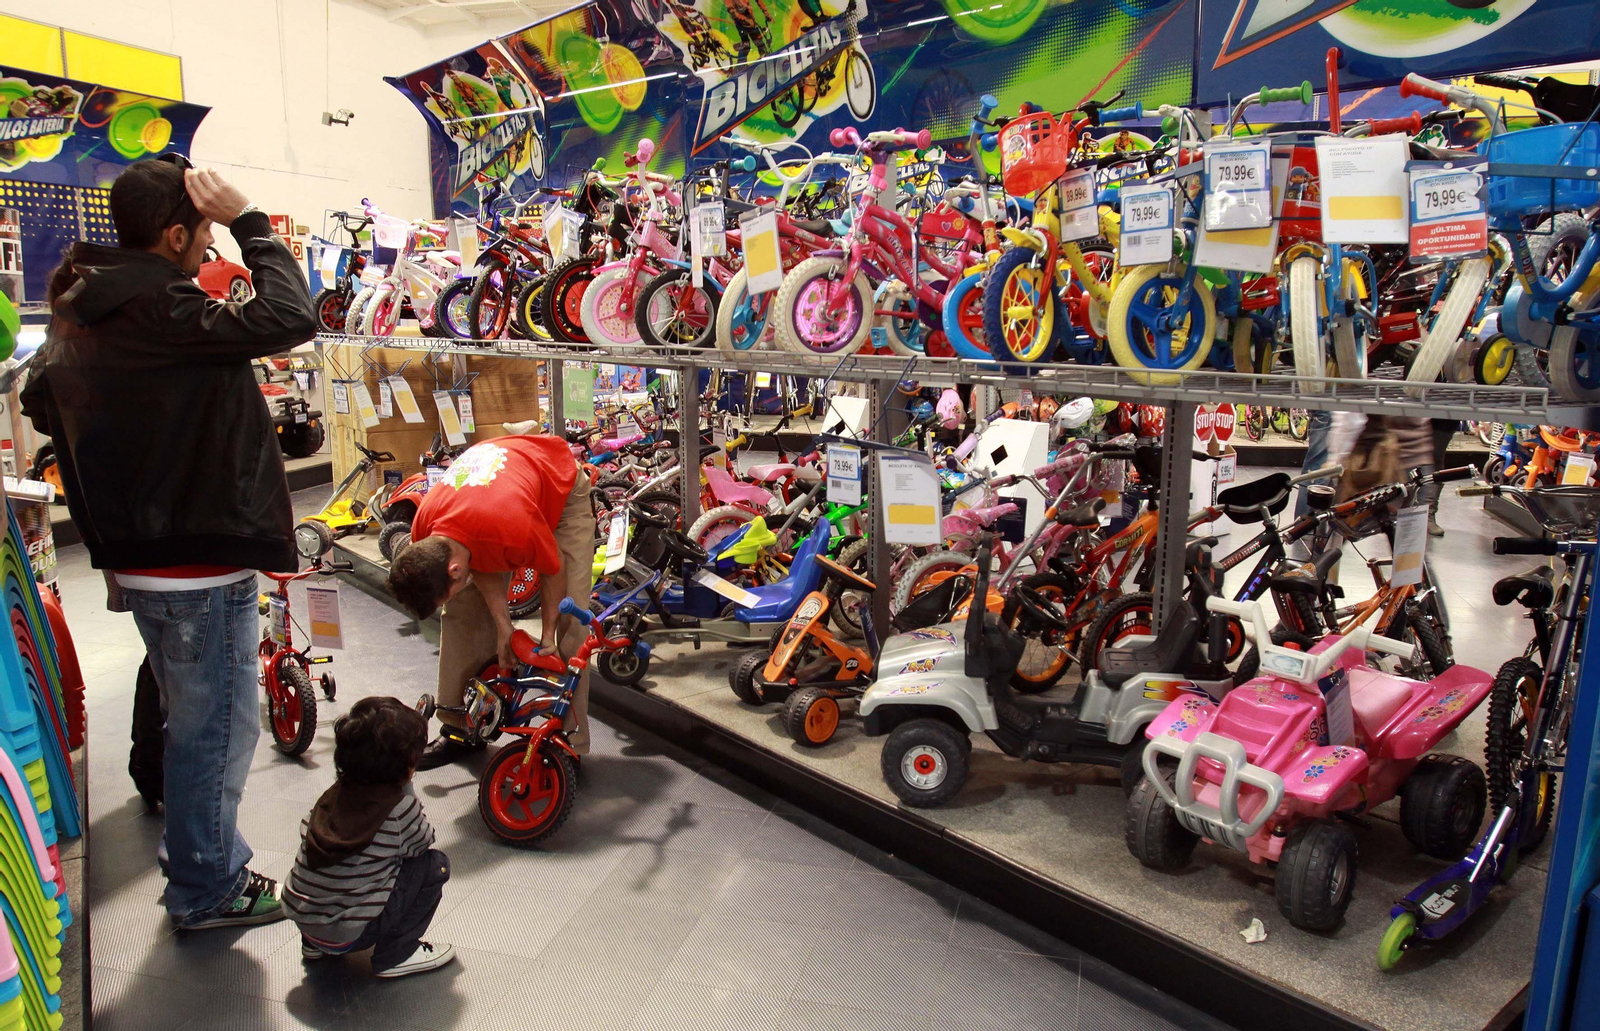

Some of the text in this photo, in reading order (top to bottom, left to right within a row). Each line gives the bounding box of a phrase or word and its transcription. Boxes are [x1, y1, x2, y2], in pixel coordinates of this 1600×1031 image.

[701, 20, 841, 140] BICICLETAS
[458, 114, 527, 187] BICICLETAS
[1425, 189, 1467, 209] 79,99€
[1131, 206, 1161, 223] 79,99€
[1197, 412, 1234, 429] STOP STOP
[834, 460, 853, 472] 79,99€
[907, 658, 935, 673] 4x4
